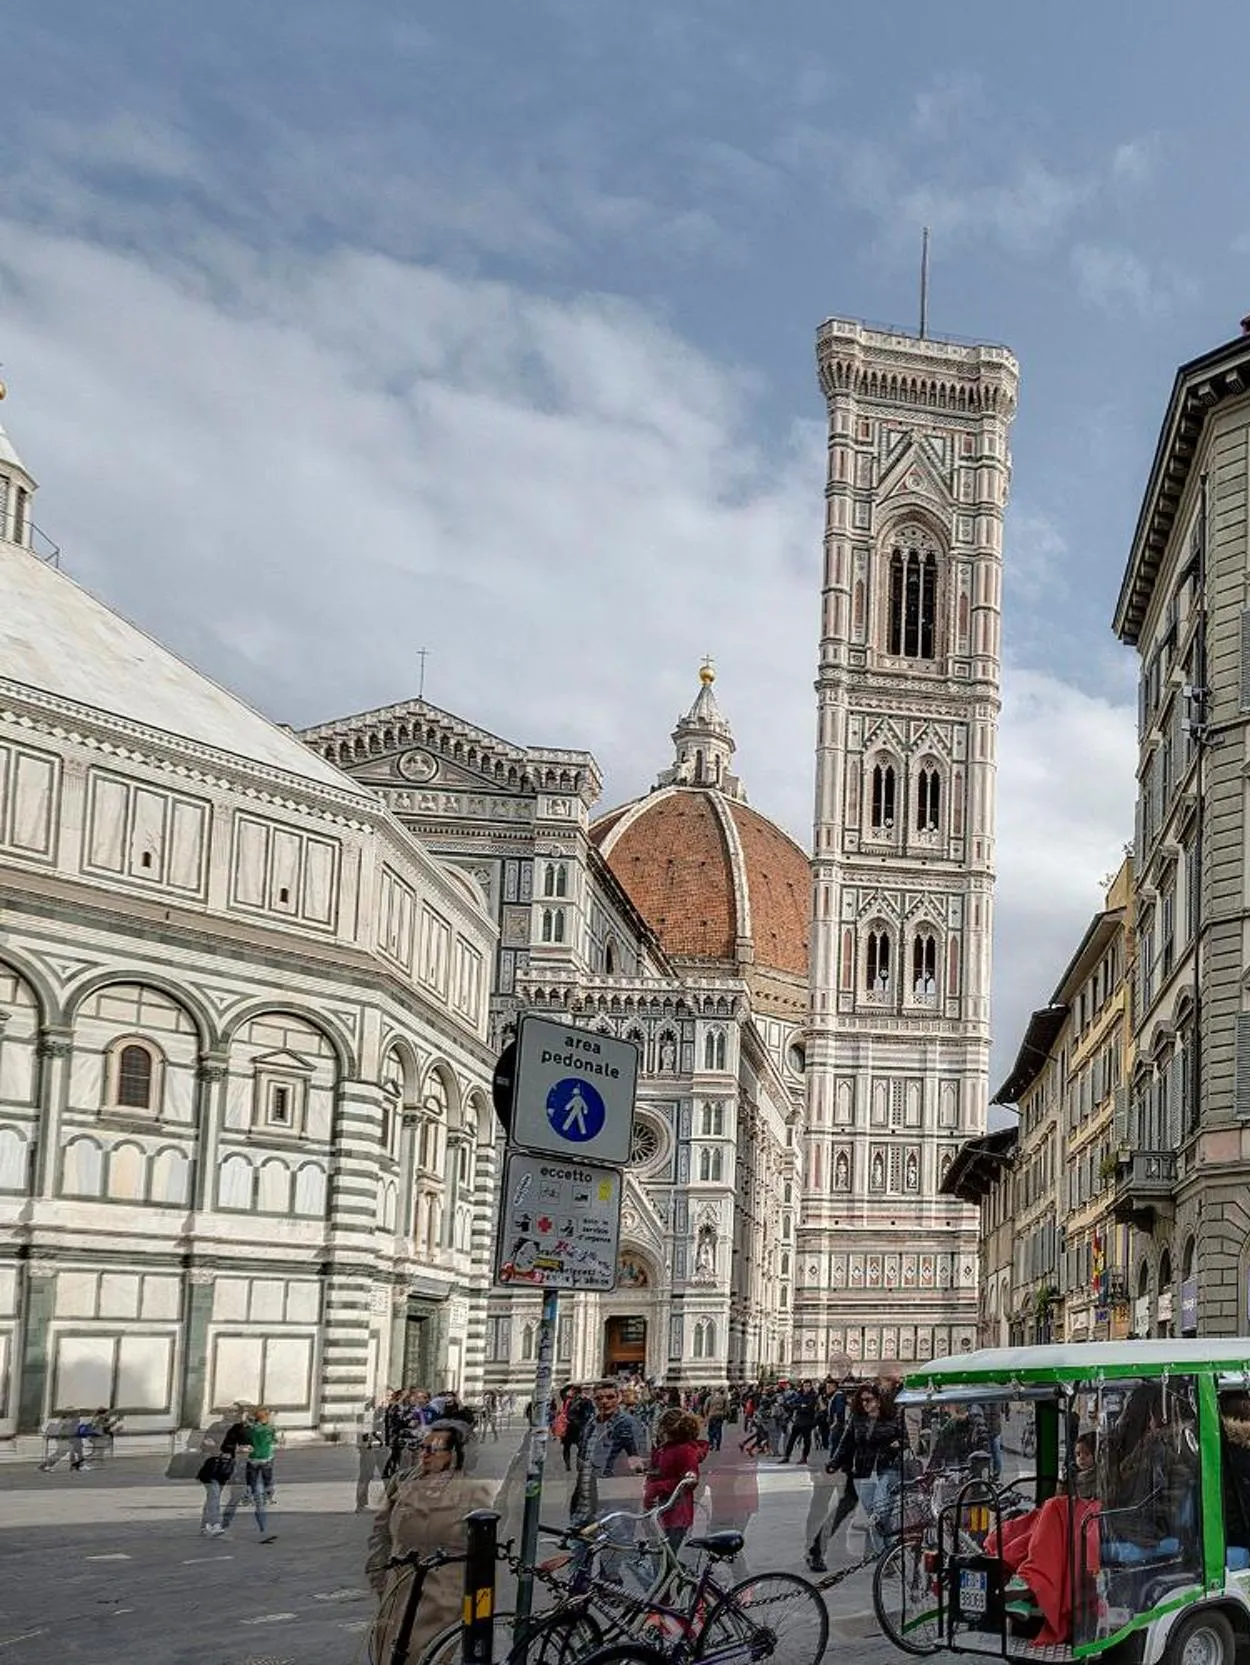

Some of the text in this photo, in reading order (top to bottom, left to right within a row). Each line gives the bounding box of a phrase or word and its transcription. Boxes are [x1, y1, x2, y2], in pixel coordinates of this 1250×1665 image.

[564, 1035, 602, 1055] area
[541, 1049, 620, 1079] pedonale
[540, 1167, 593, 1183] eccetto
